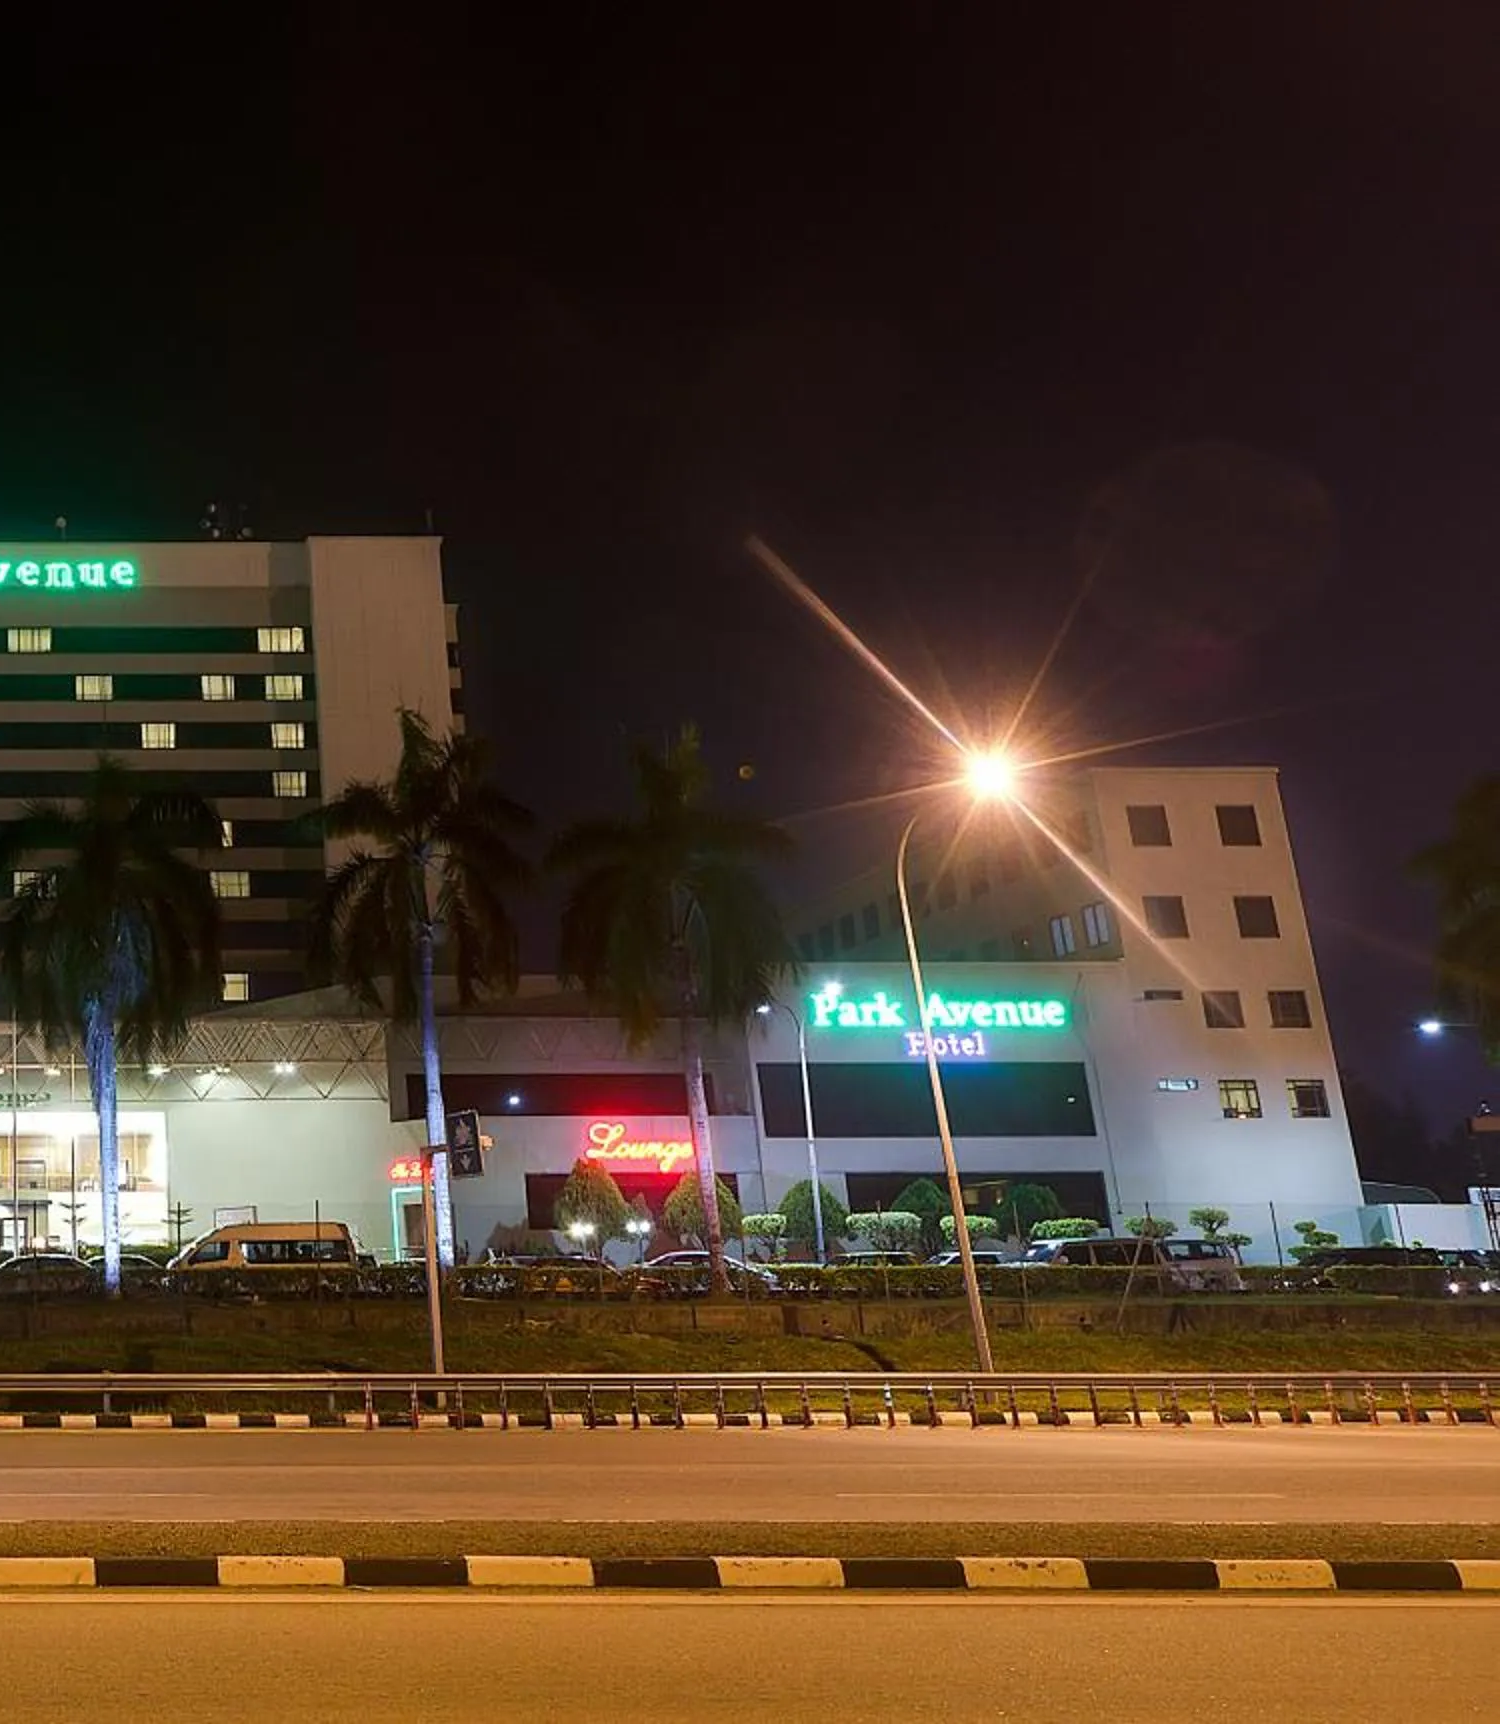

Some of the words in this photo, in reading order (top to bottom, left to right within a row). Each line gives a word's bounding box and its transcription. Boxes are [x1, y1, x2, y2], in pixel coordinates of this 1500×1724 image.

[810, 992, 907, 1028] Park
[924, 992, 1066, 1028] Avenue
[904, 1031, 987, 1057] Hotel
[584, 1121, 695, 1173] Lounge
